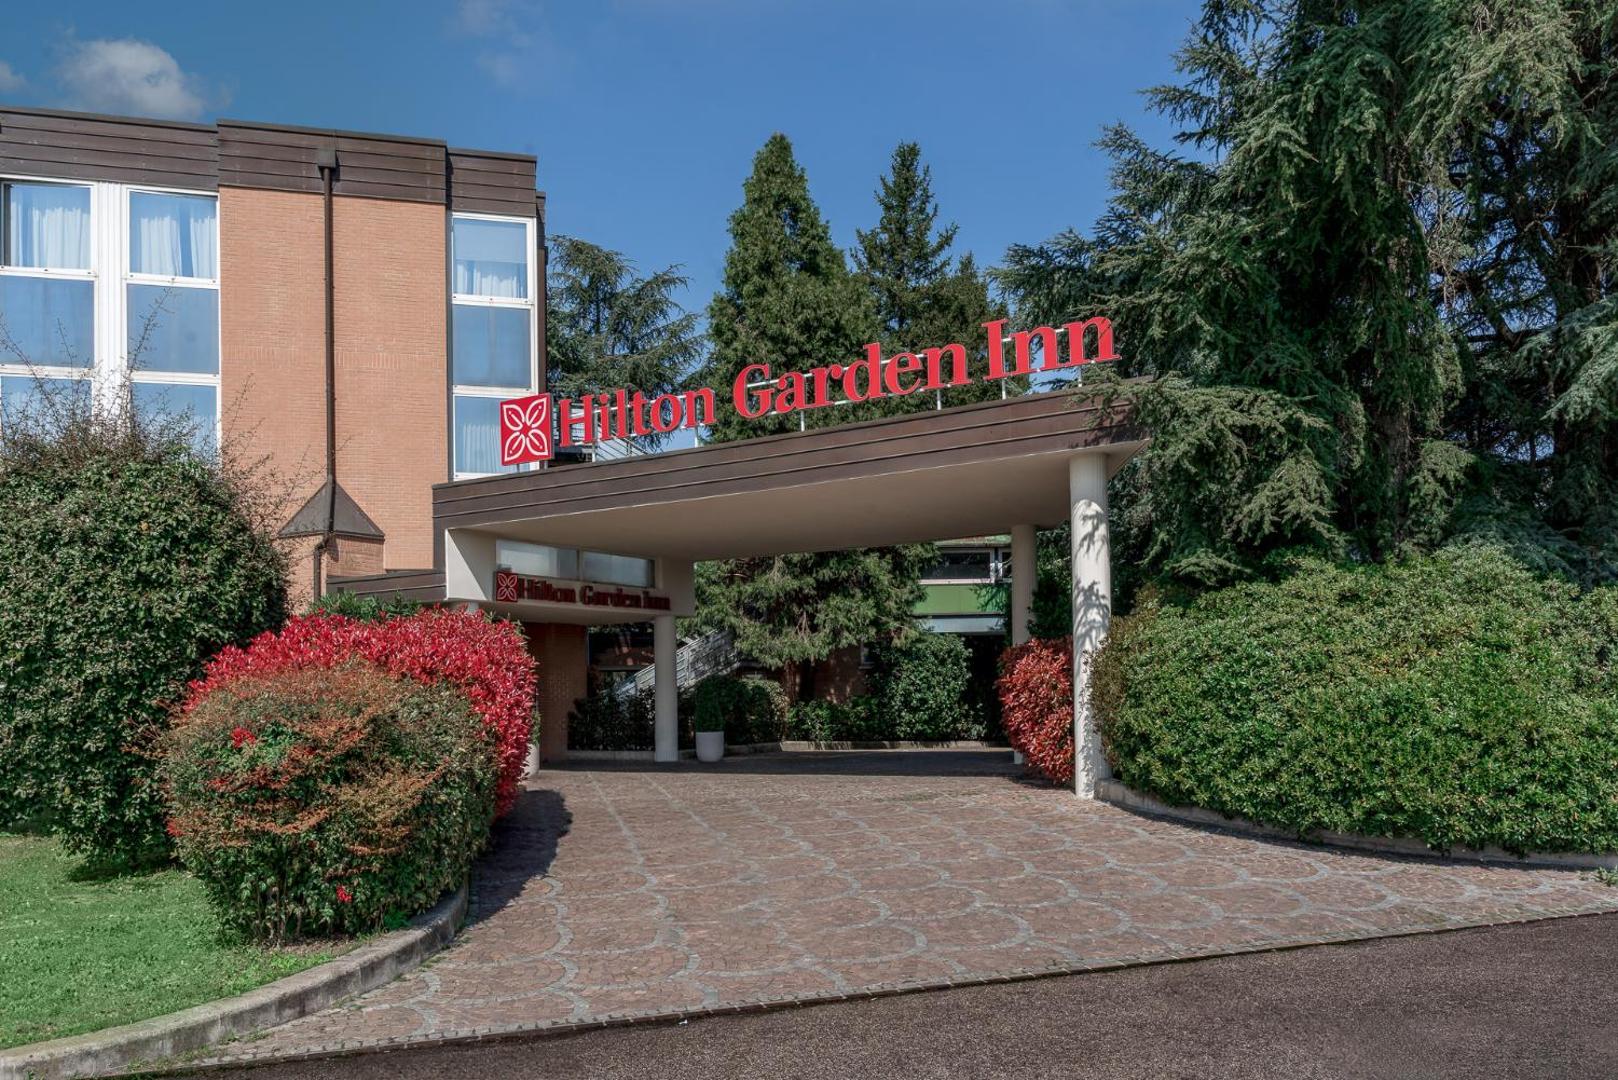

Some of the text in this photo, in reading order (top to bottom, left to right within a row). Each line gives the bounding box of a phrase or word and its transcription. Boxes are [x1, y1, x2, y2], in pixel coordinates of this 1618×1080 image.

[559, 316, 1122, 447] Hilton Garden Inn
[518, 577, 576, 603] Hilton
[580, 585, 641, 609] Garden
